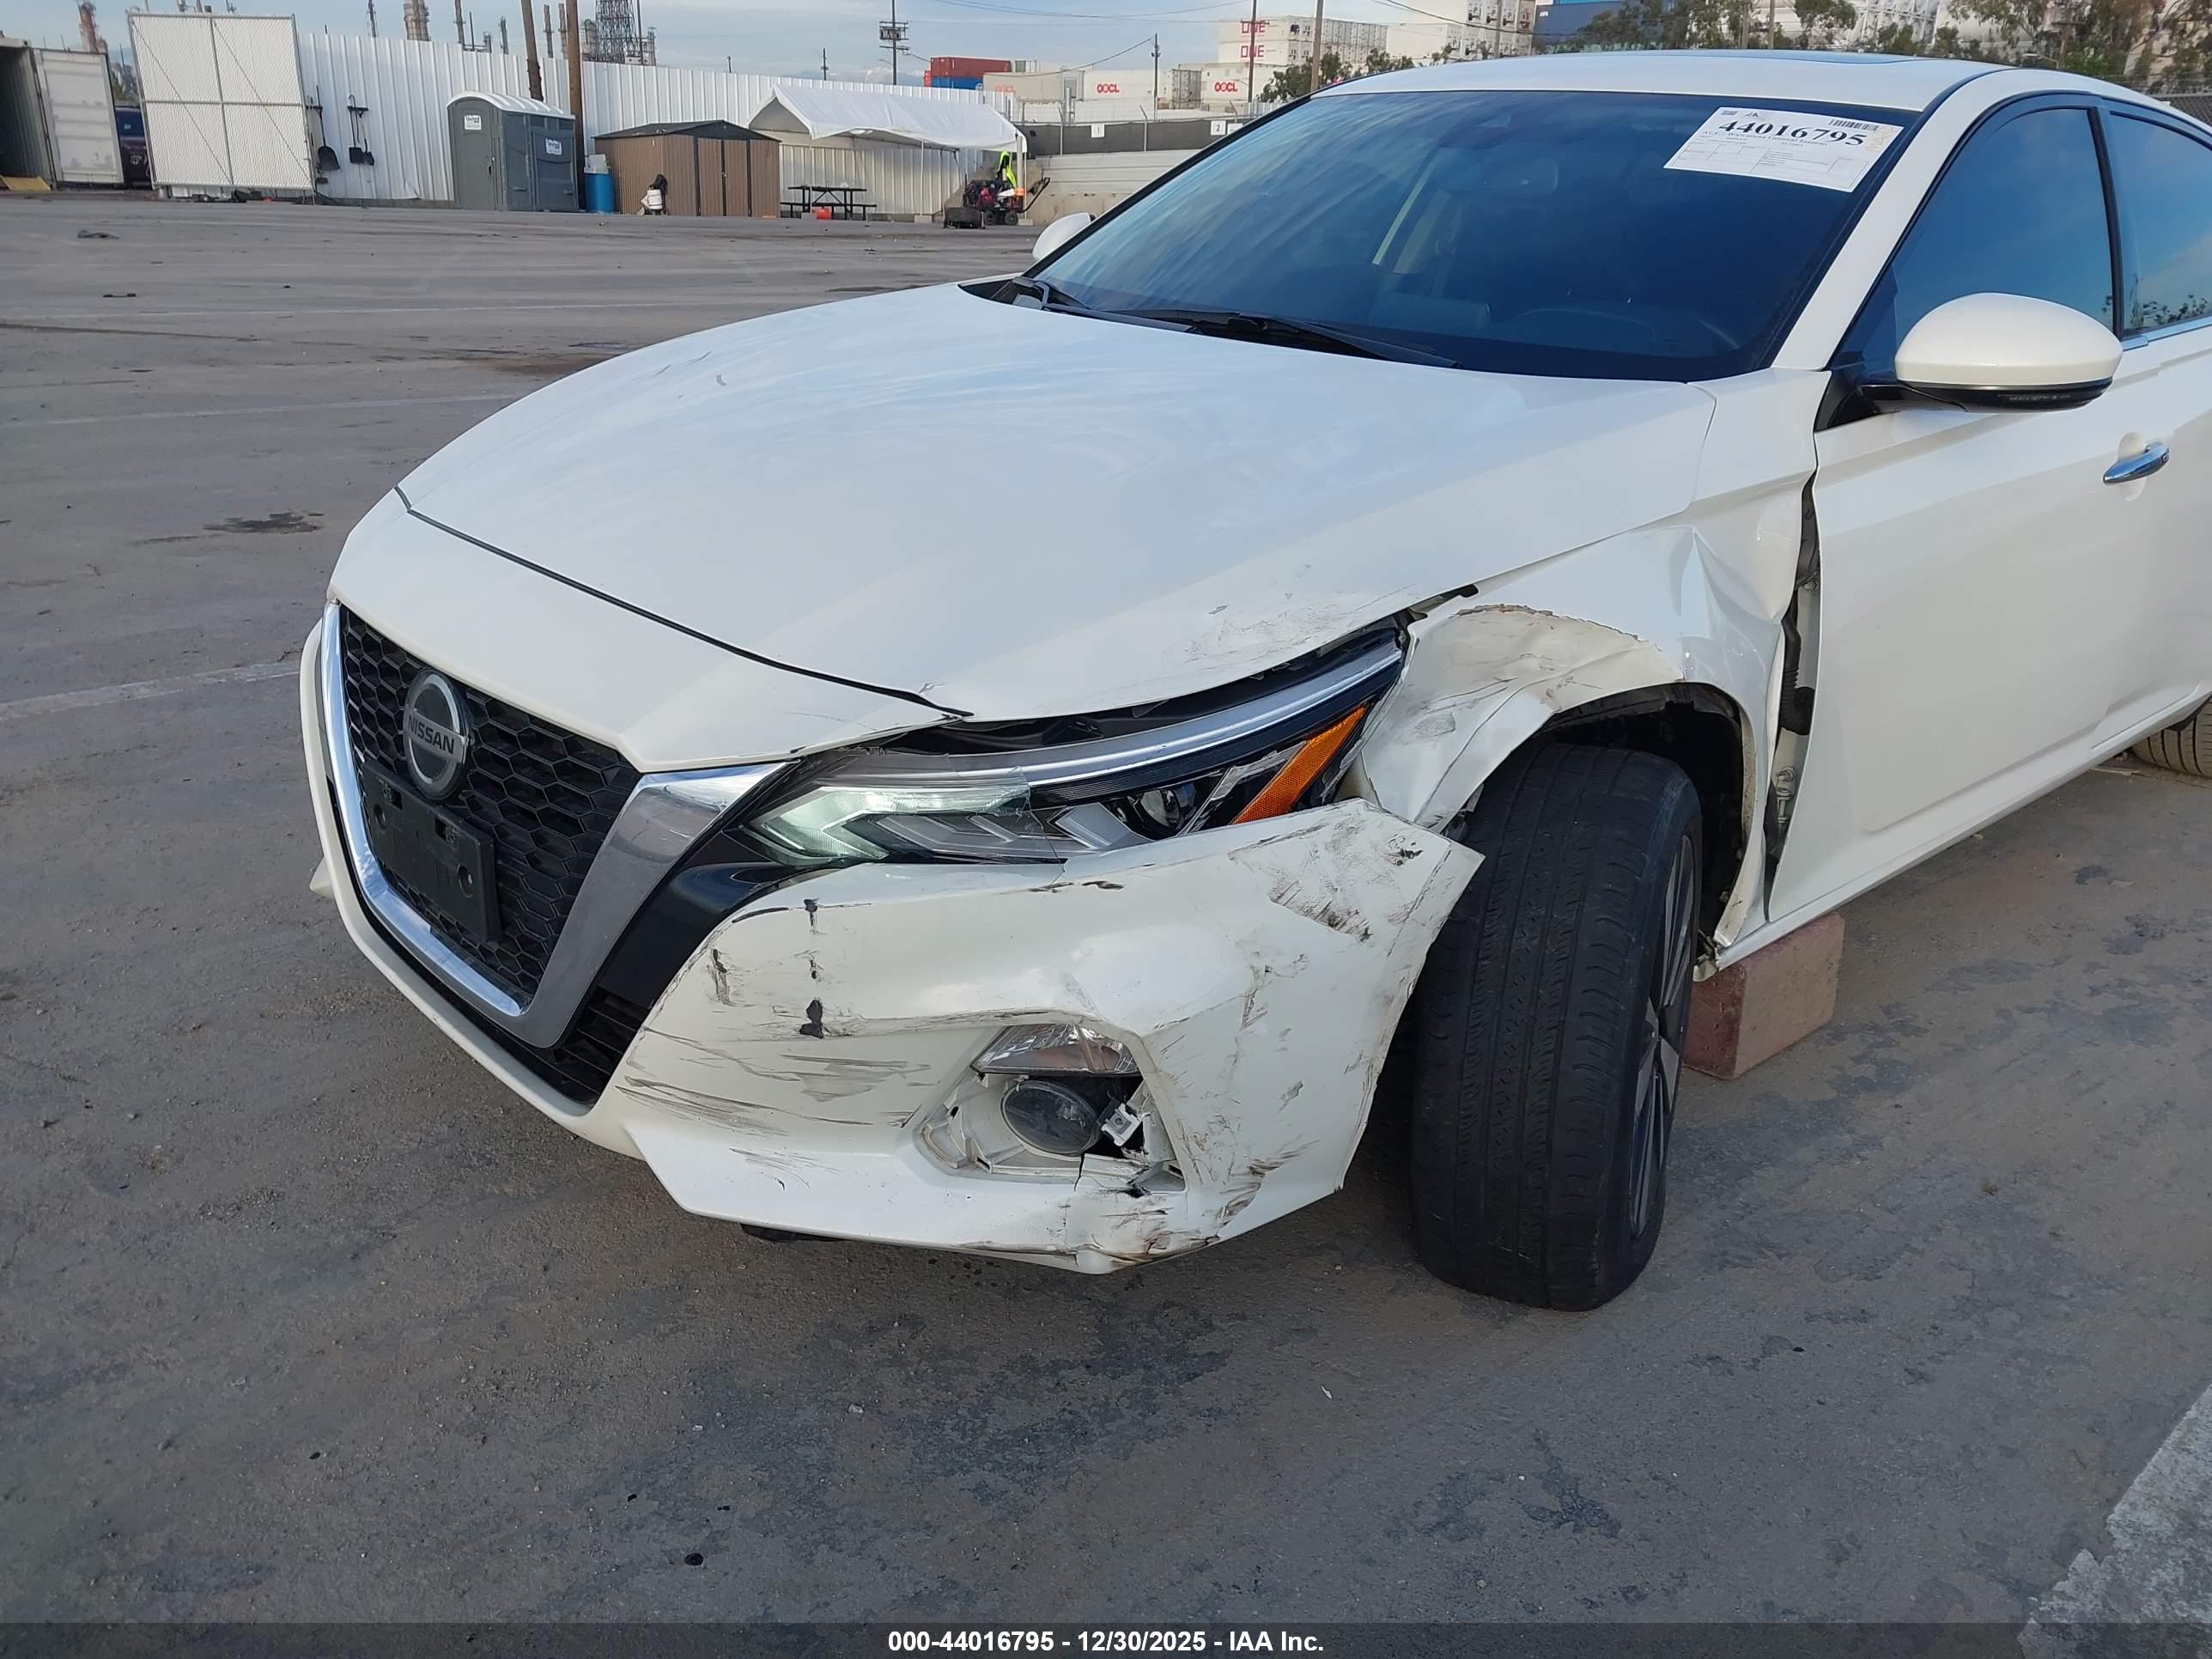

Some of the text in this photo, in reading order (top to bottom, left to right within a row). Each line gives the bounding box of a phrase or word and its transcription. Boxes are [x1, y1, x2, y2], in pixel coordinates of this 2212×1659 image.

[1097, 83, 1120, 93] OOCL
[1214, 82, 1237, 92] OOCL
[1718, 120, 1869, 146] 44016795
[409, 714, 454, 755] NISSAN
